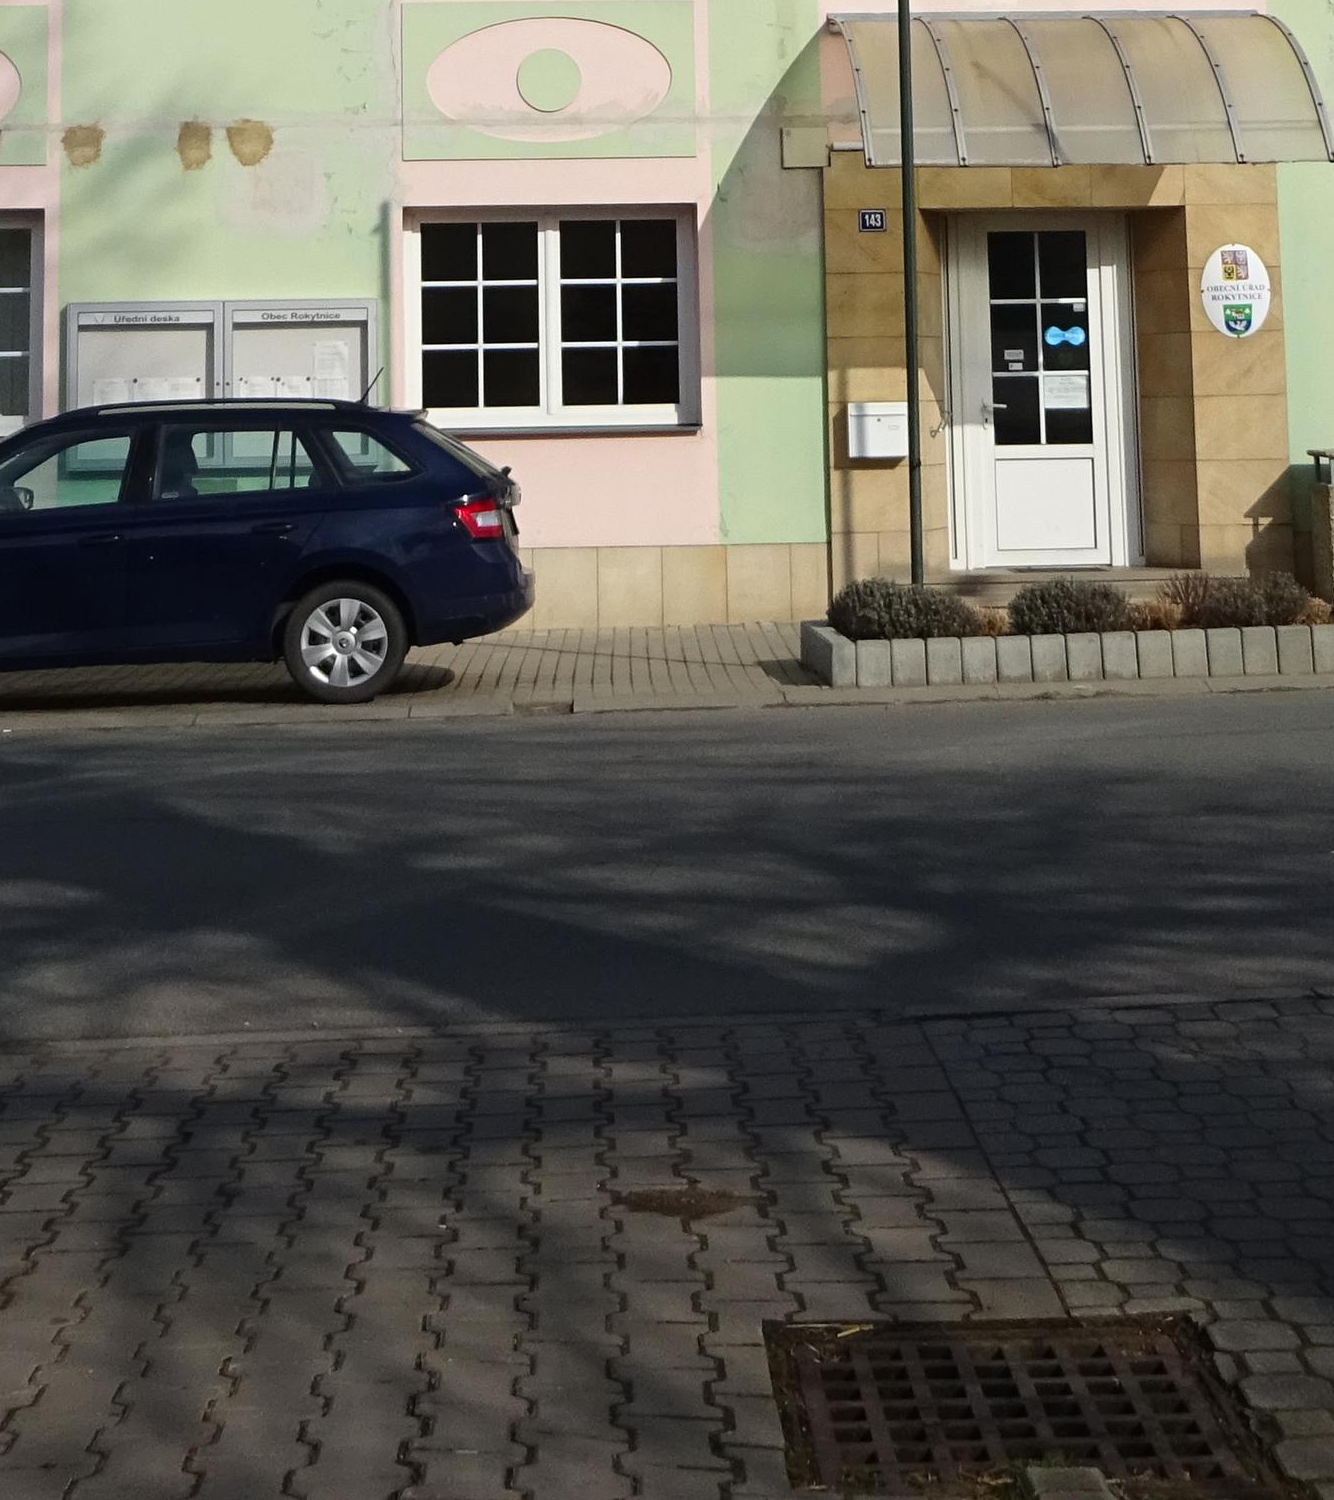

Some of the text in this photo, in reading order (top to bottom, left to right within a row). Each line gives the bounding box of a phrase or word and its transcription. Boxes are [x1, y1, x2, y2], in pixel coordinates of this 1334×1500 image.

[864, 214, 882, 227] 143
[1211, 293, 1263, 301] ROKYTNICE
[261, 311, 341, 321] Obec Rokytnice
